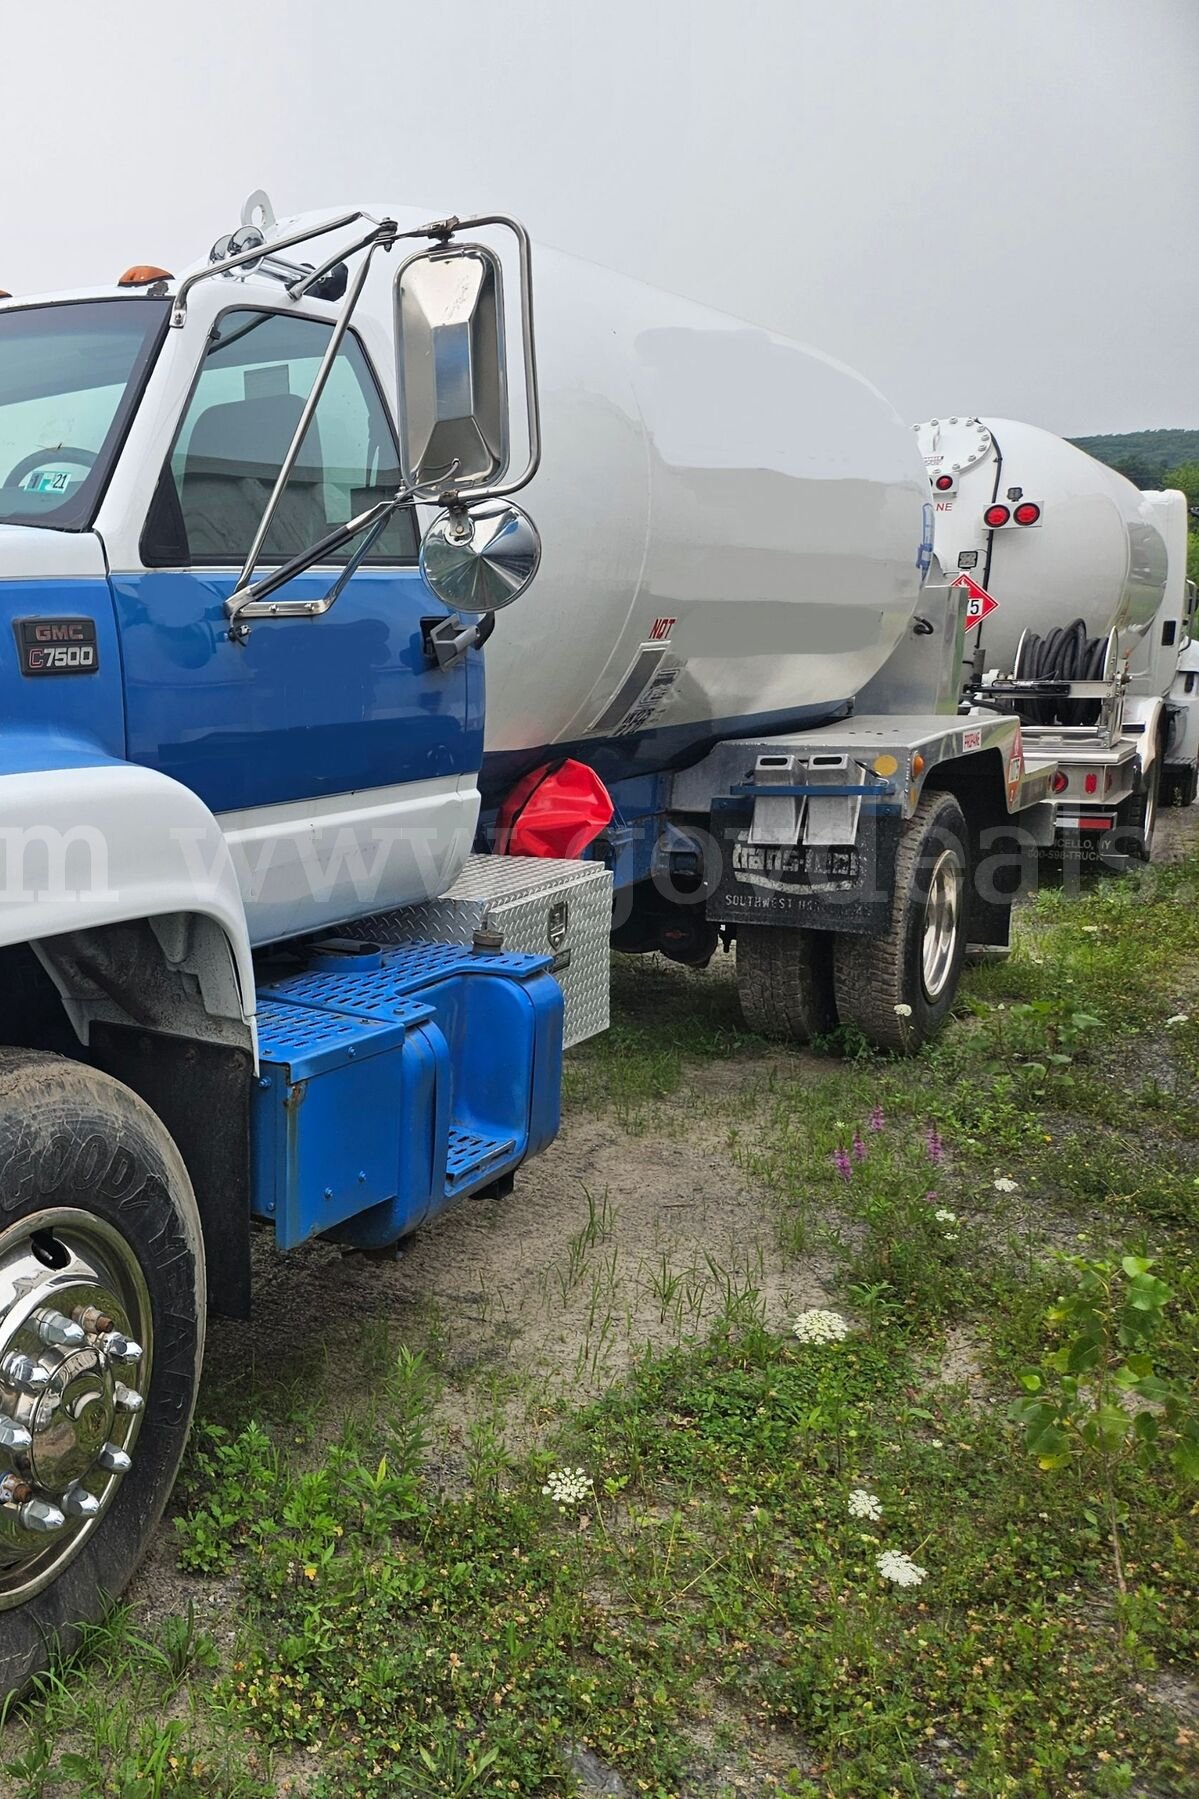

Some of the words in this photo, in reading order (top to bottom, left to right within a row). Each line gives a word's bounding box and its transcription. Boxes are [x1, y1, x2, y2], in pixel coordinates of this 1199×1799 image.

[52, 473, 67, 489] 21
[35, 625, 84, 641] GMC
[29, 646, 94, 668] C7500
[725, 893, 793, 910] SOUTHWEST
